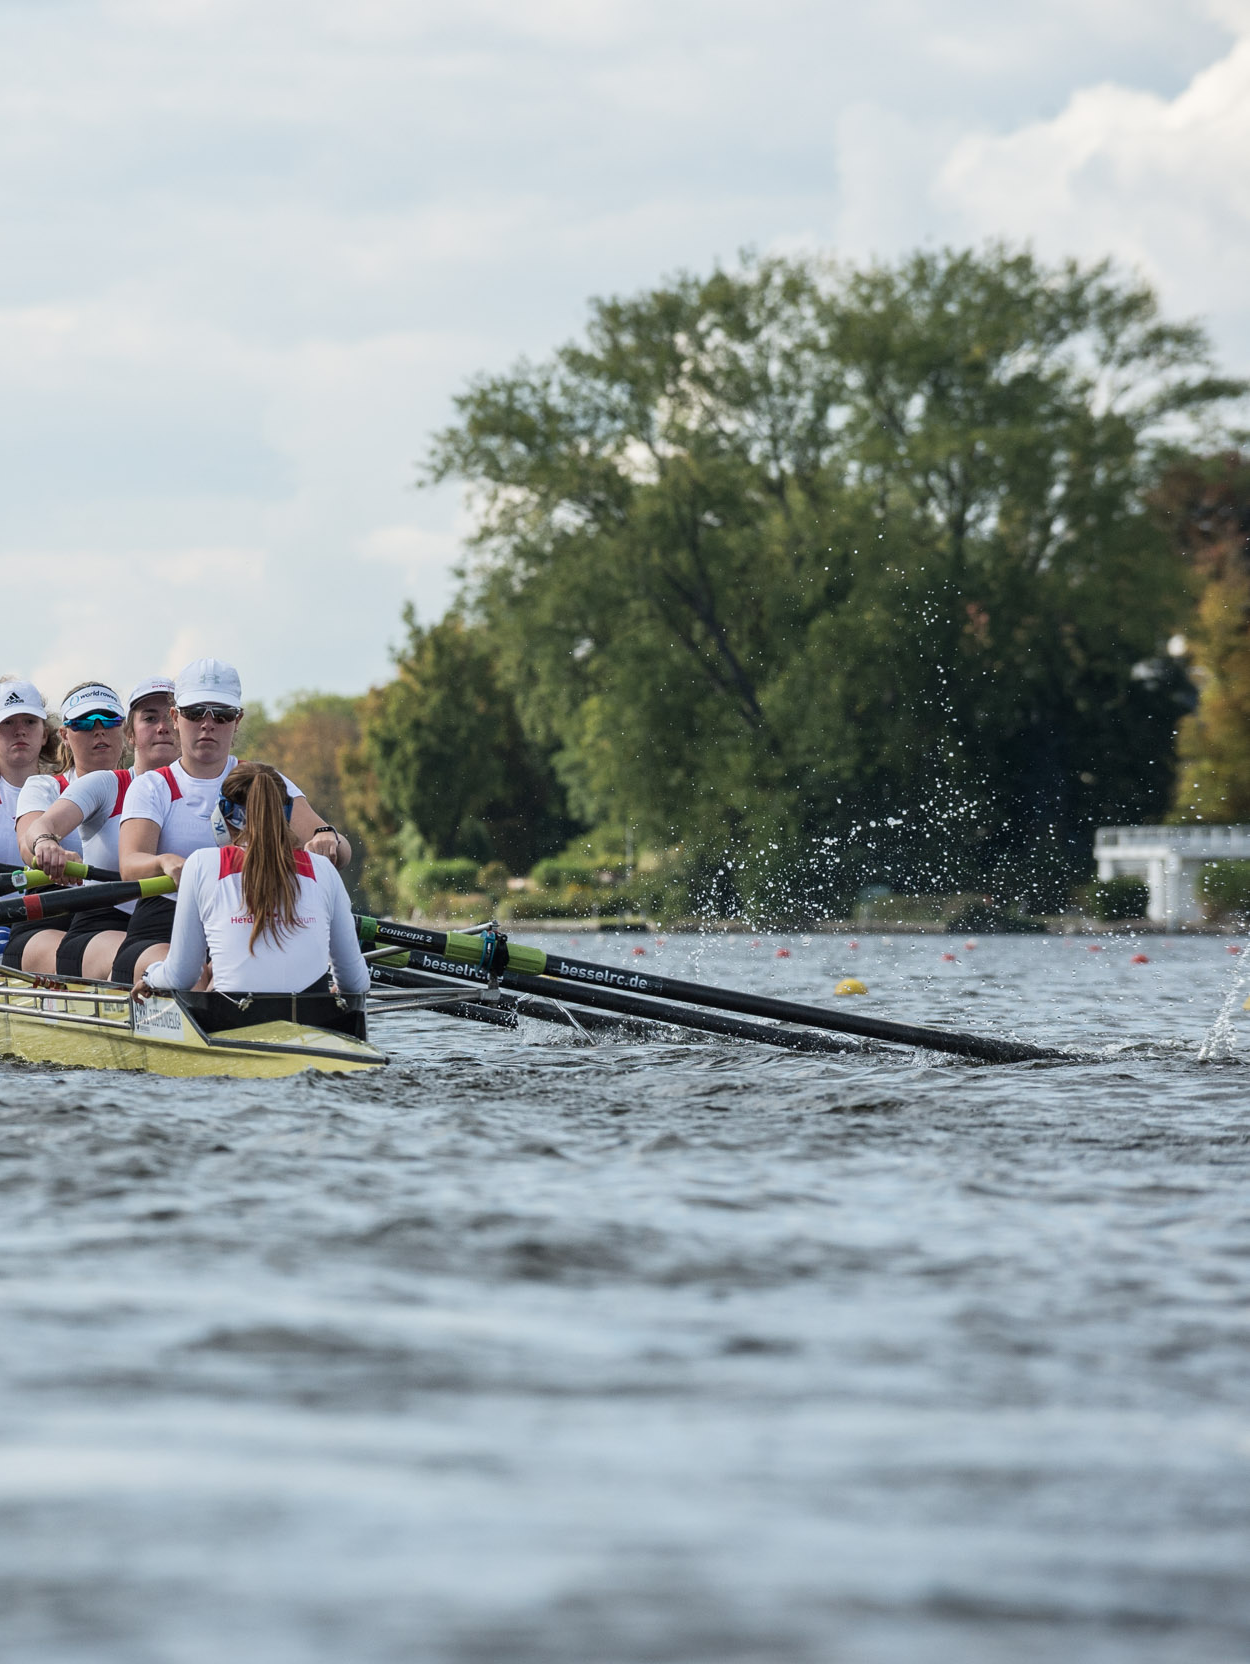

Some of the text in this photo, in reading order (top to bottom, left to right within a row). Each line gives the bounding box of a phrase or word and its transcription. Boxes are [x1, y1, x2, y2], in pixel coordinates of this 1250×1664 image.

[80, 690, 100, 700] world
[4, 699, 25, 707] adidas
[380, 926, 425, 941] concept
[425, 935, 433, 943] 2
[560, 961, 648, 989] besselrc.de
